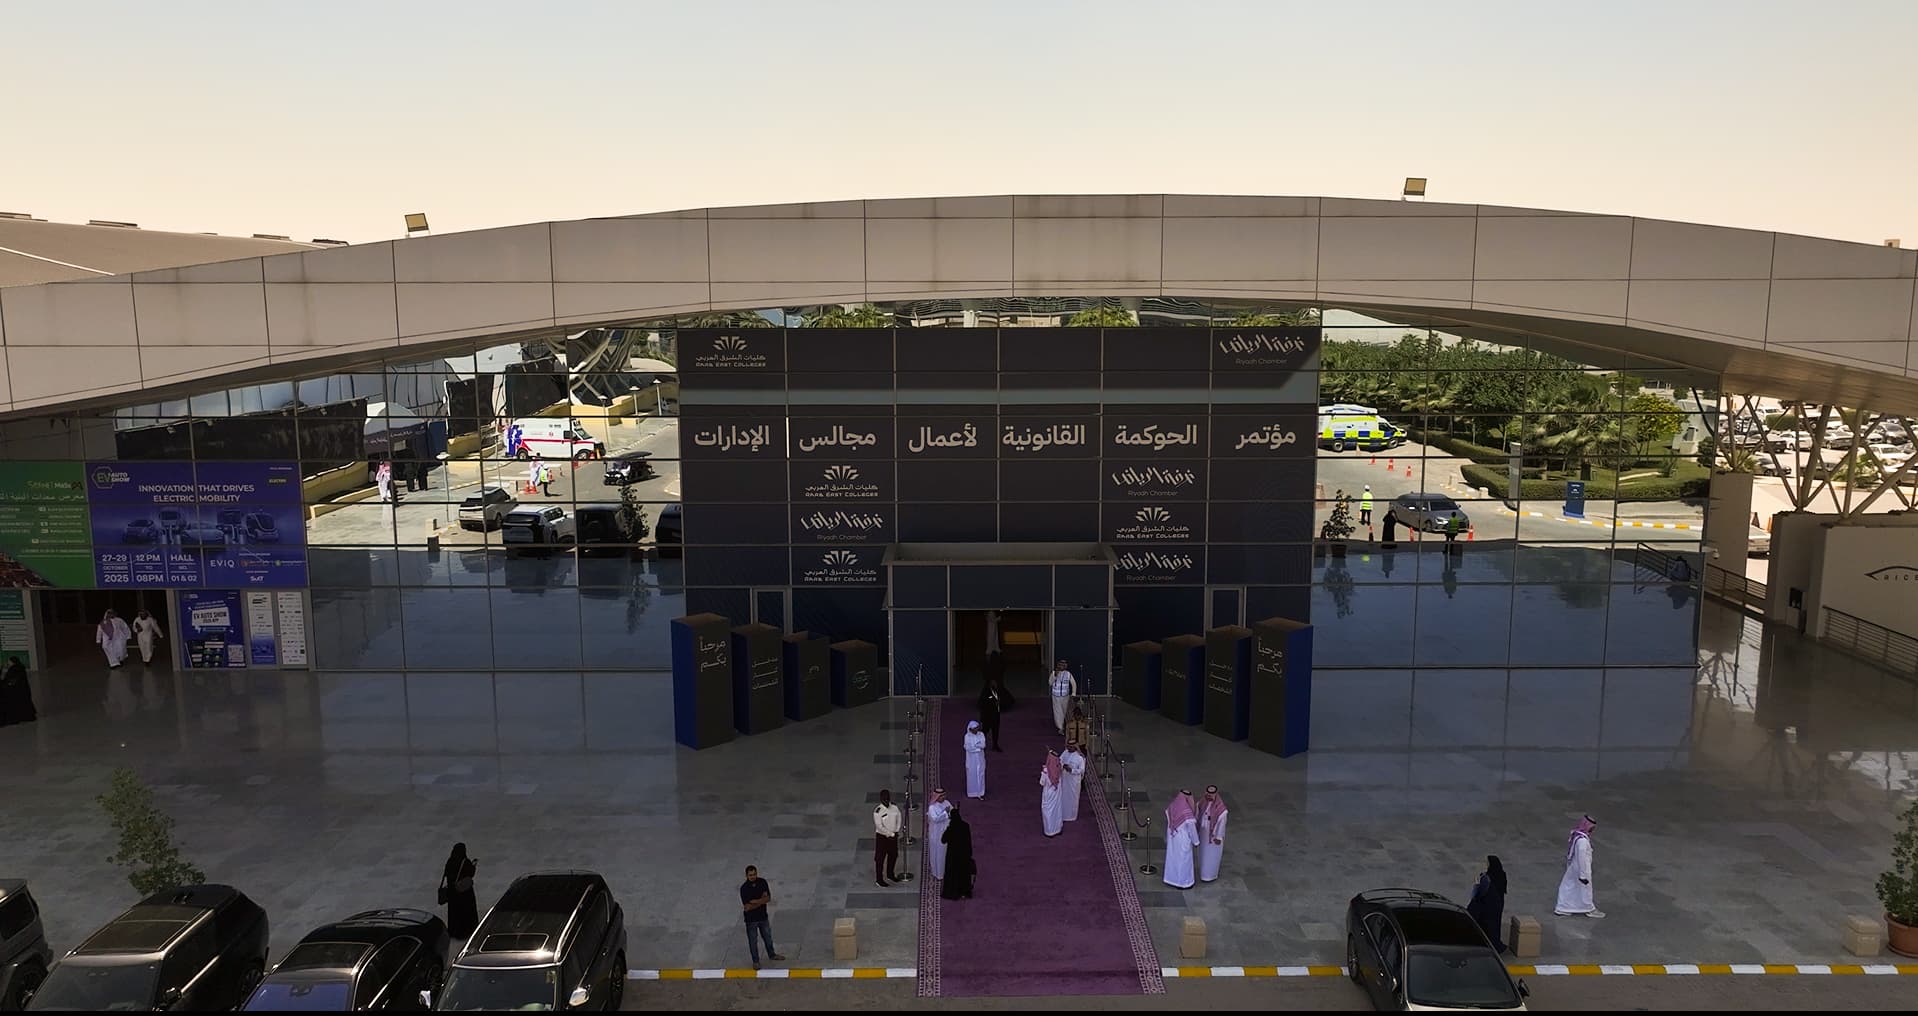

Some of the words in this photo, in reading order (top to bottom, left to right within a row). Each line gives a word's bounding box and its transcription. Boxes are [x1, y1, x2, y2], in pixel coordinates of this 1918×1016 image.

[694, 424, 771, 453] الإدارات
[798, 424, 878, 453] مجالس
[908, 423, 979, 453] لأعمال
[1002, 424, 1086, 451] القانونية
[1114, 424, 1198, 452] الحوكمة
[1235, 423, 1297, 450] مؤتمر
[138, 484, 194, 493] INNOVATION
[198, 484, 223, 493] THAT
[223, 484, 255, 493] DRIVES
[153, 494, 195, 503] ELECTRIC
[199, 494, 241, 503] MOBILITY
[146, 554, 161, 562] PM
[170, 554, 195, 562] HALL
[104, 574, 129, 583] 2025
